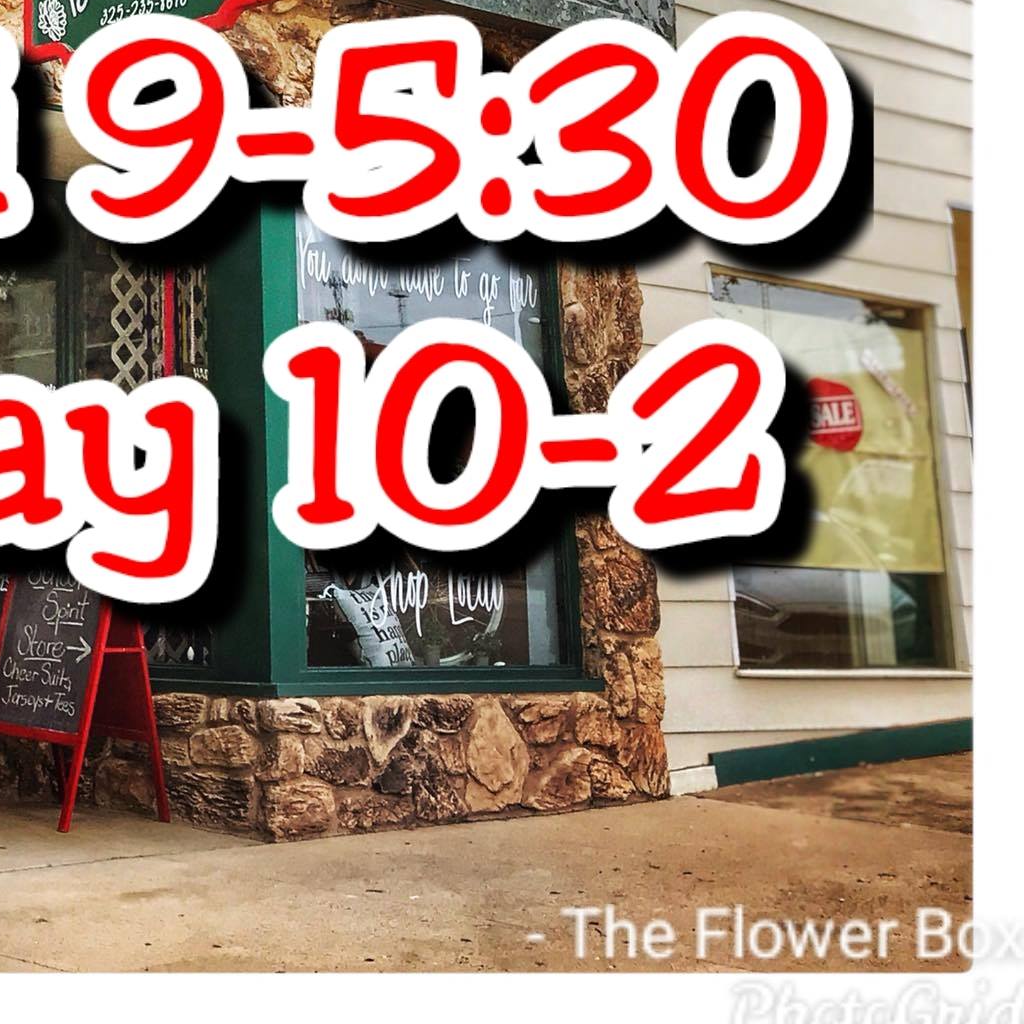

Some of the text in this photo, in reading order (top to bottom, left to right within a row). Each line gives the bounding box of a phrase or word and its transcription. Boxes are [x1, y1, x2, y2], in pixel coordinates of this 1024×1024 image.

[296, 230, 333, 290] You
[452, 256, 472, 299] to
[478, 264, 501, 327] go
[812, 401, 856, 429] SALE
[41, 589, 91, 636] Spirit
[17, 624, 67, 658] Store
[2, 656, 39, 682] Cheer
